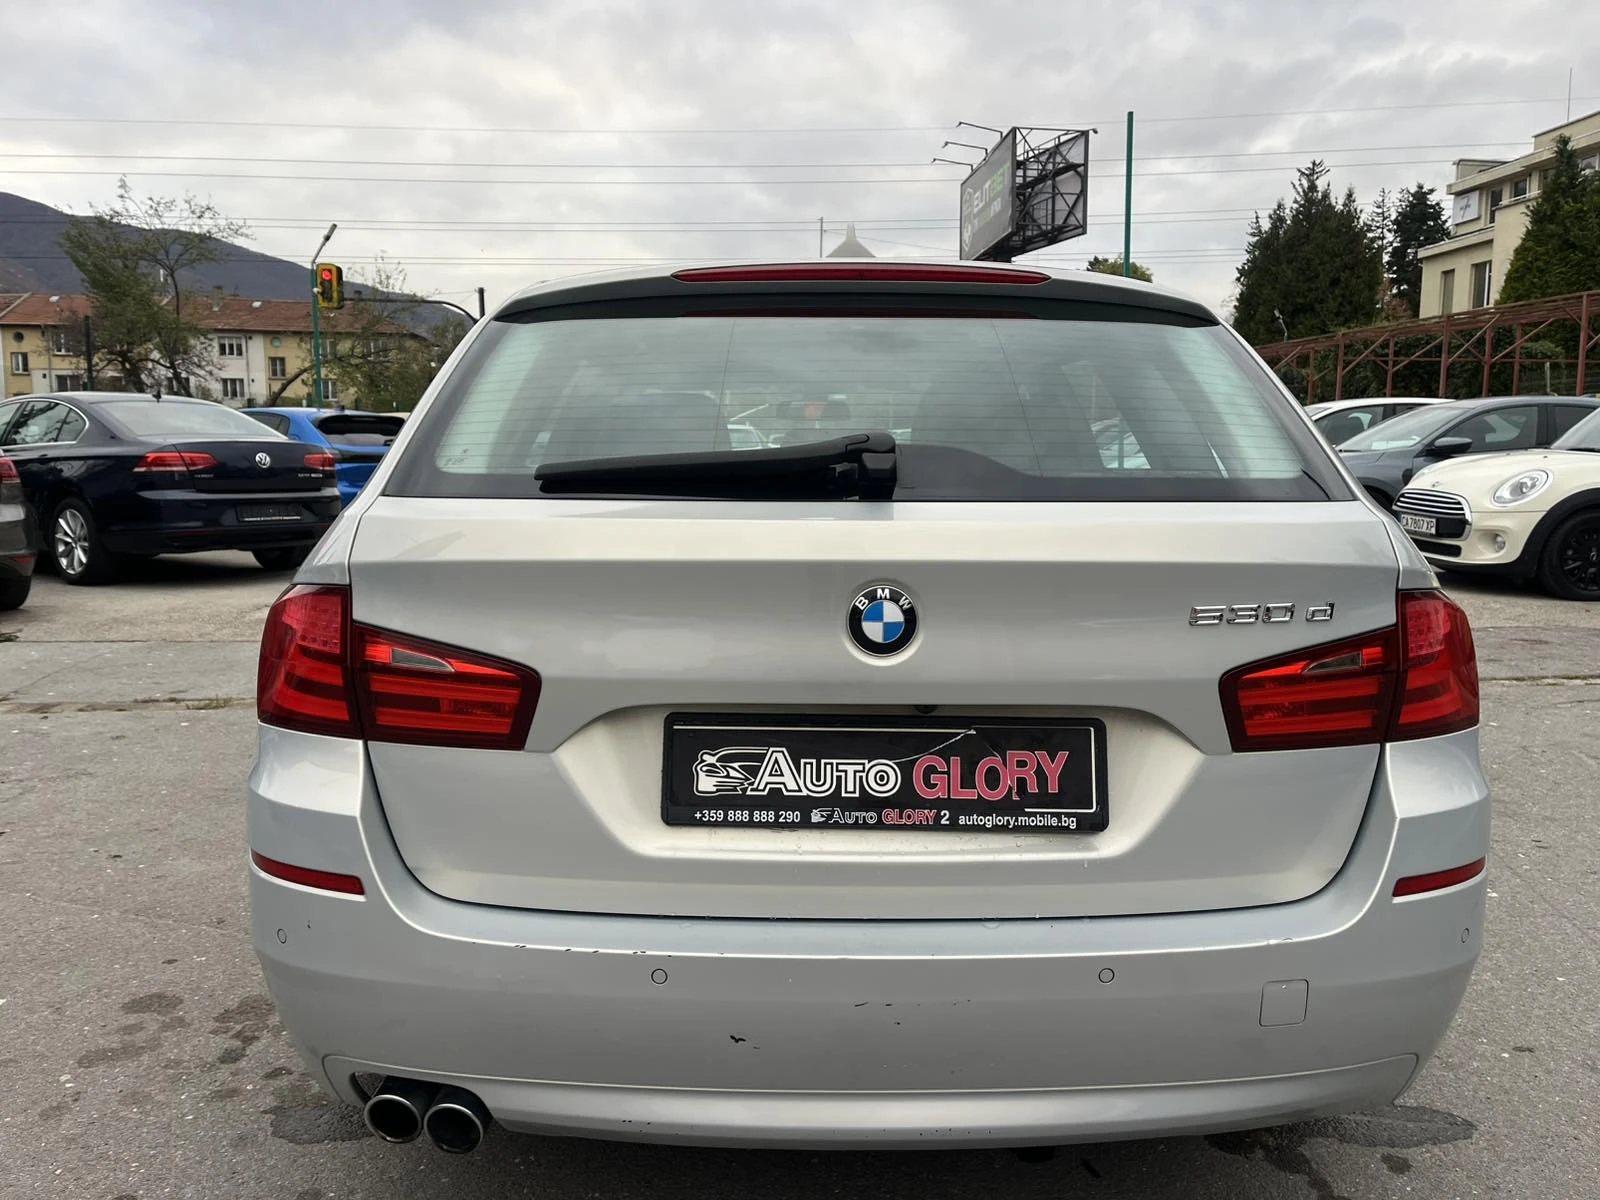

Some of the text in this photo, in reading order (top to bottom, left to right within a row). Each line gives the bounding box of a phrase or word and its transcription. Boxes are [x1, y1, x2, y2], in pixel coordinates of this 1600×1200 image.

[855, 588, 912, 610] BMW
[1188, 601, 1335, 626] 530 d
[913, 751, 1069, 801] GLORY
[694, 810, 801, 823] +359 888 888 290
[881, 809, 937, 825] GLORY
[940, 810, 950, 824] 2
[958, 813, 1077, 829] autoglory.mobile.bg
